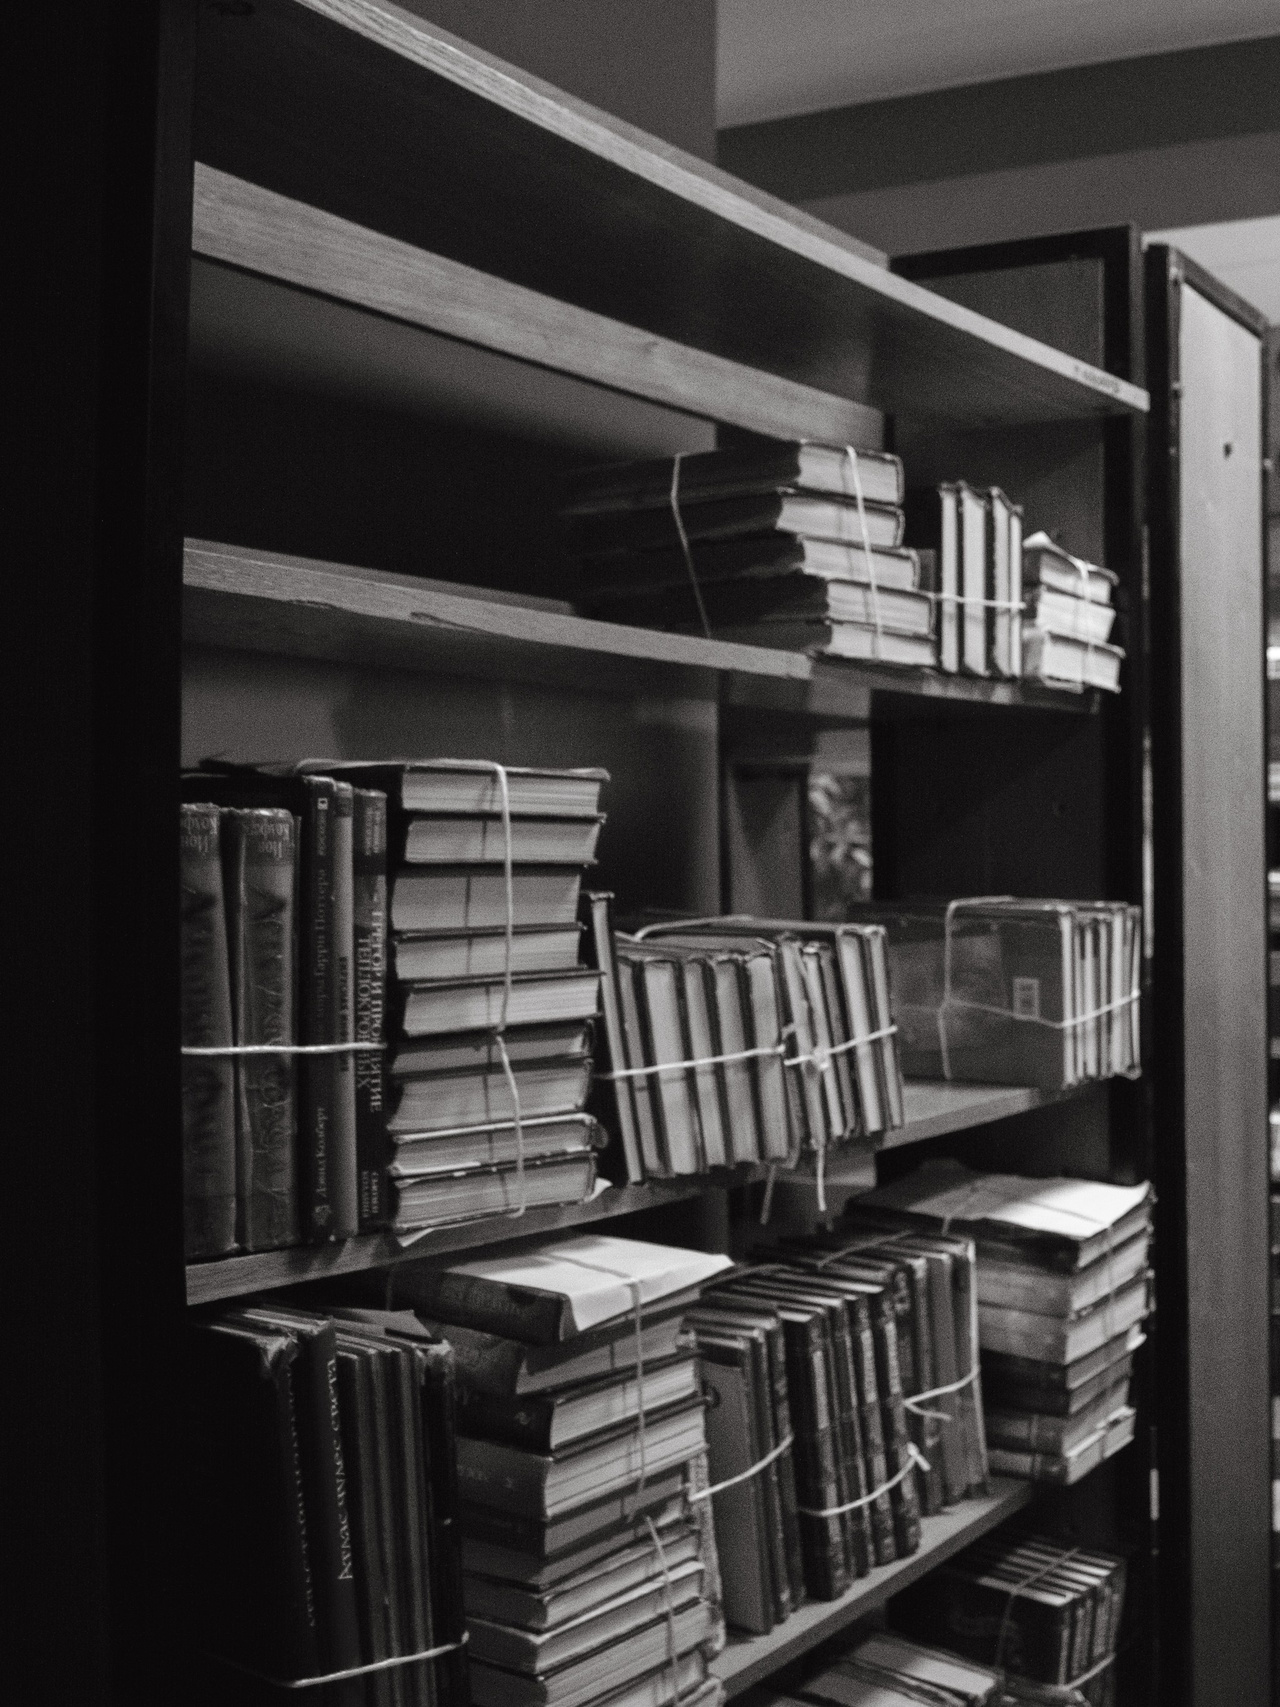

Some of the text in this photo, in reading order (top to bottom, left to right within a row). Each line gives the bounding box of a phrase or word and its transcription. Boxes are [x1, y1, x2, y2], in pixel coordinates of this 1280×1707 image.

[314, 868, 328, 931] Поттера
[314, 935, 328, 977] Гарри
[371, 910, 384, 976] ГРЕГОР
[371, 981, 384, 994] И
